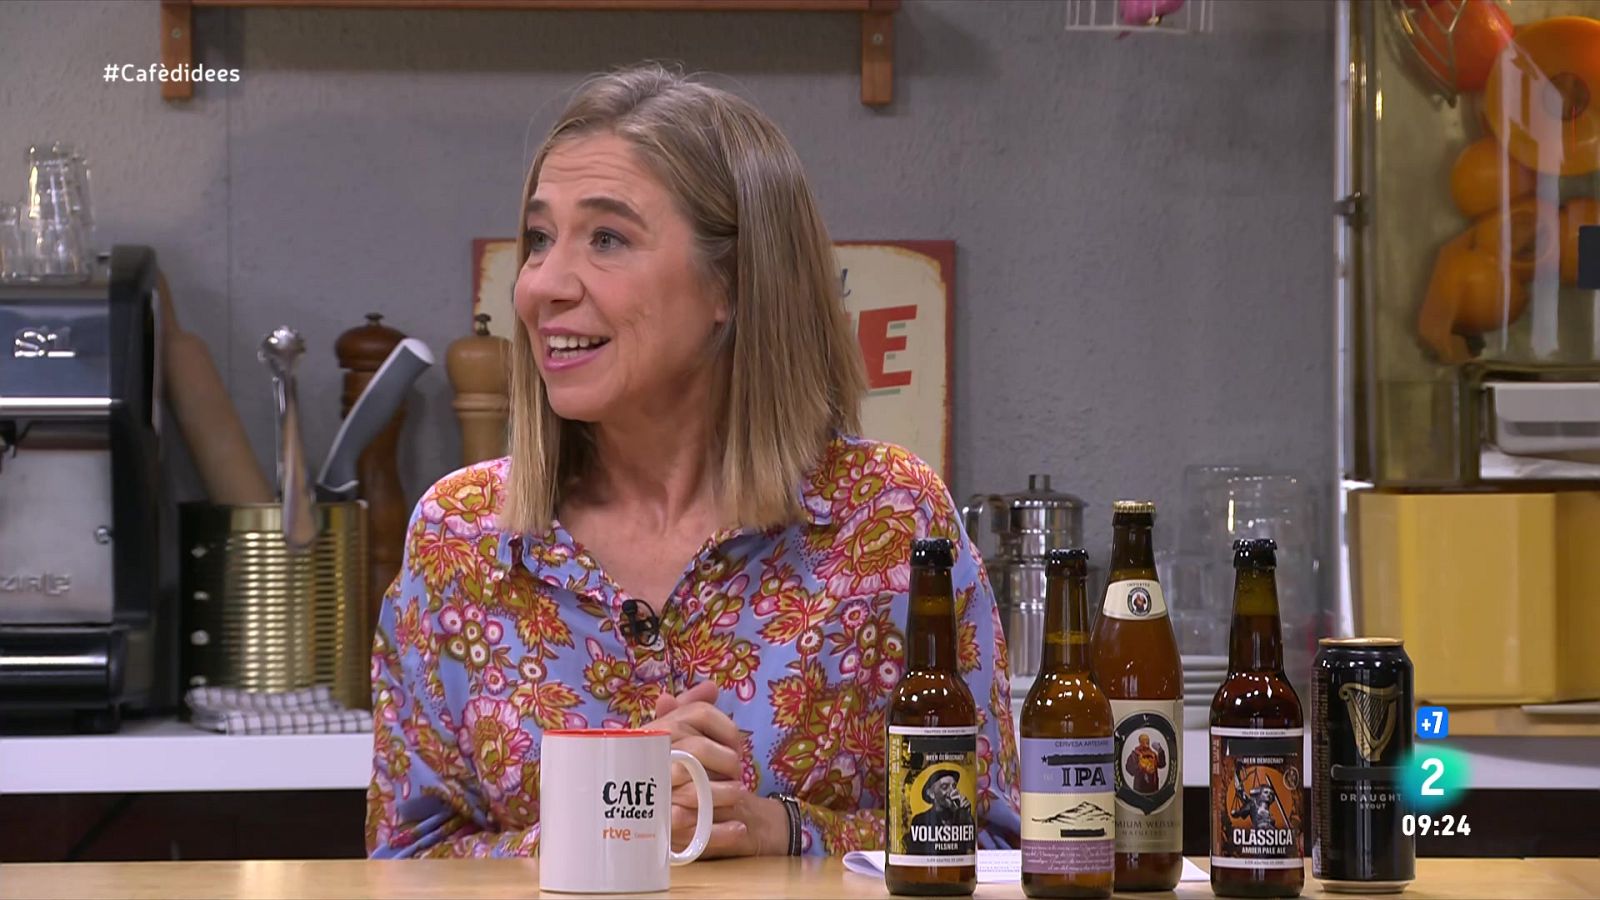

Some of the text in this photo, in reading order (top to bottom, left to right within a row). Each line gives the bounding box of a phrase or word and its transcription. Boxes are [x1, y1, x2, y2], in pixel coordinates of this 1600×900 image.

[1061, 766, 1107, 787] IPA
[602, 777, 657, 806] CAFÈ
[1340, 793, 1402, 802] DRAUGHT
[602, 826, 631, 841] rtve
[911, 824, 974, 842] VOLKSBIER
[934, 842, 959, 851] PILSNER
[1241, 846, 1287, 855] AMBER PALE ALE
